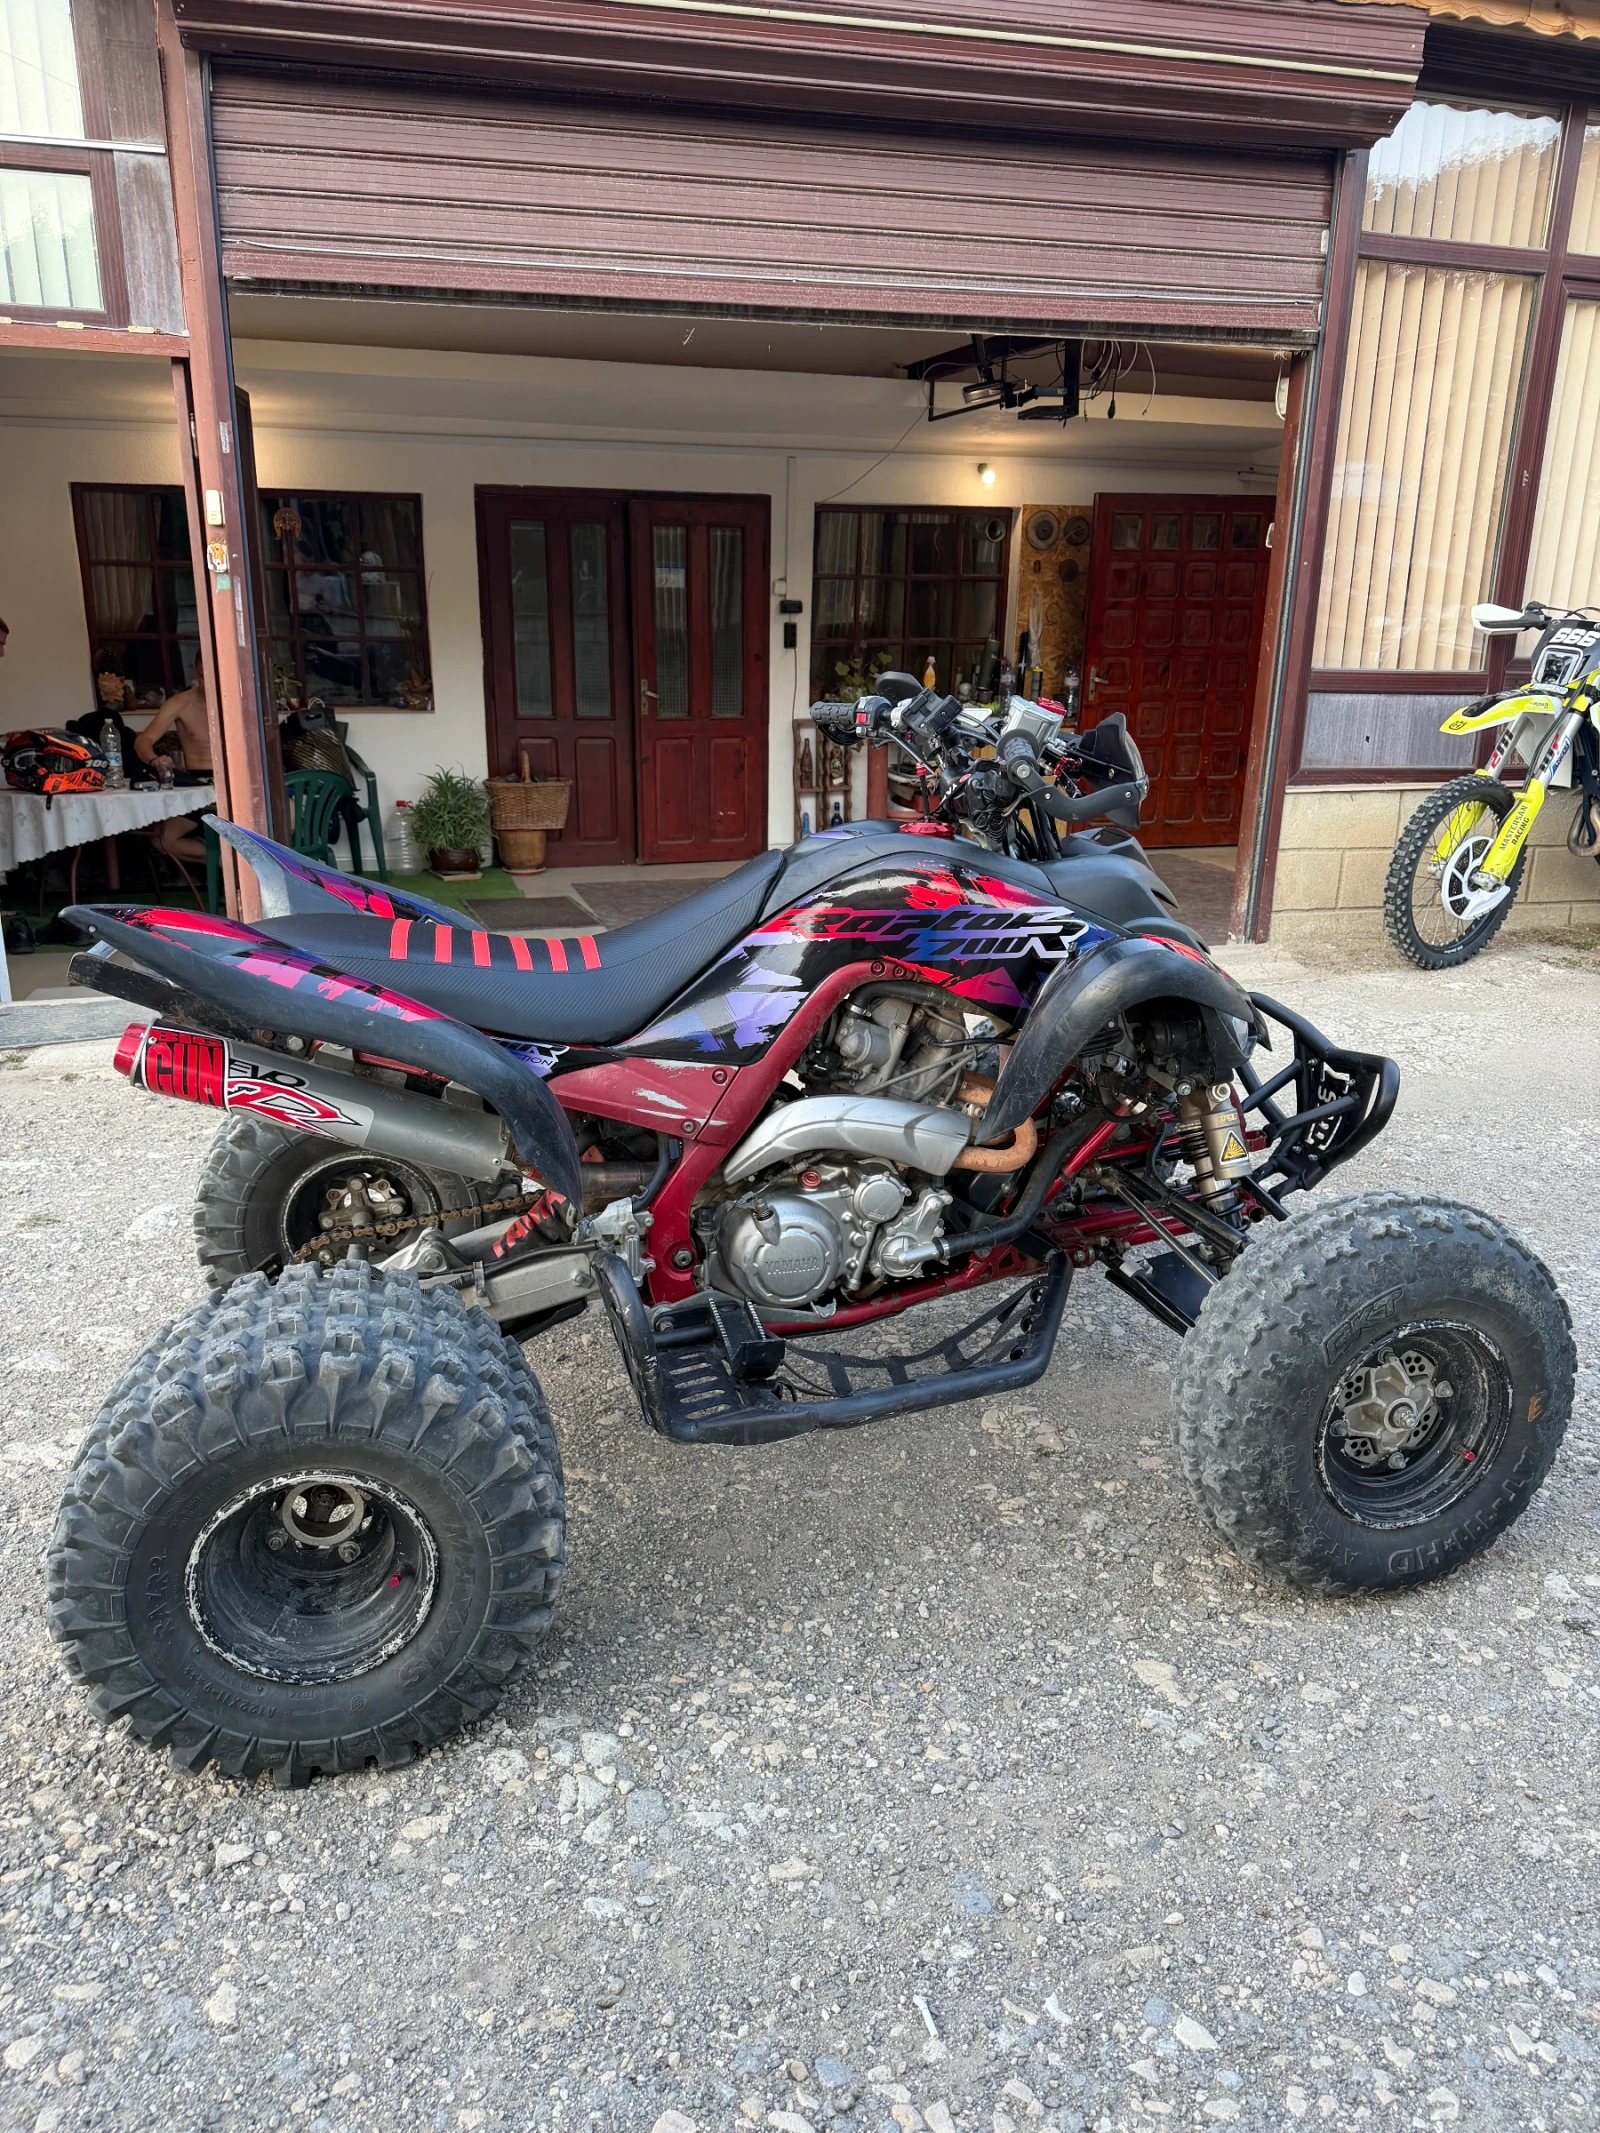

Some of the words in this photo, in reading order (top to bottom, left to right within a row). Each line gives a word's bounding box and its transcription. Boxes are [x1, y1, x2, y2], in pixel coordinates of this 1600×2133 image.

[1549, 628, 1600, 647] 666
[1511, 817, 1530, 846] RACING
[159, 1031, 223, 1048] BIG
[146, 1042, 224, 1109] GUN
[229, 1058, 307, 1088] EVO
[765, 1257, 820, 1275] YAMAHA
[399, 1523, 476, 1689] MAXXIS
